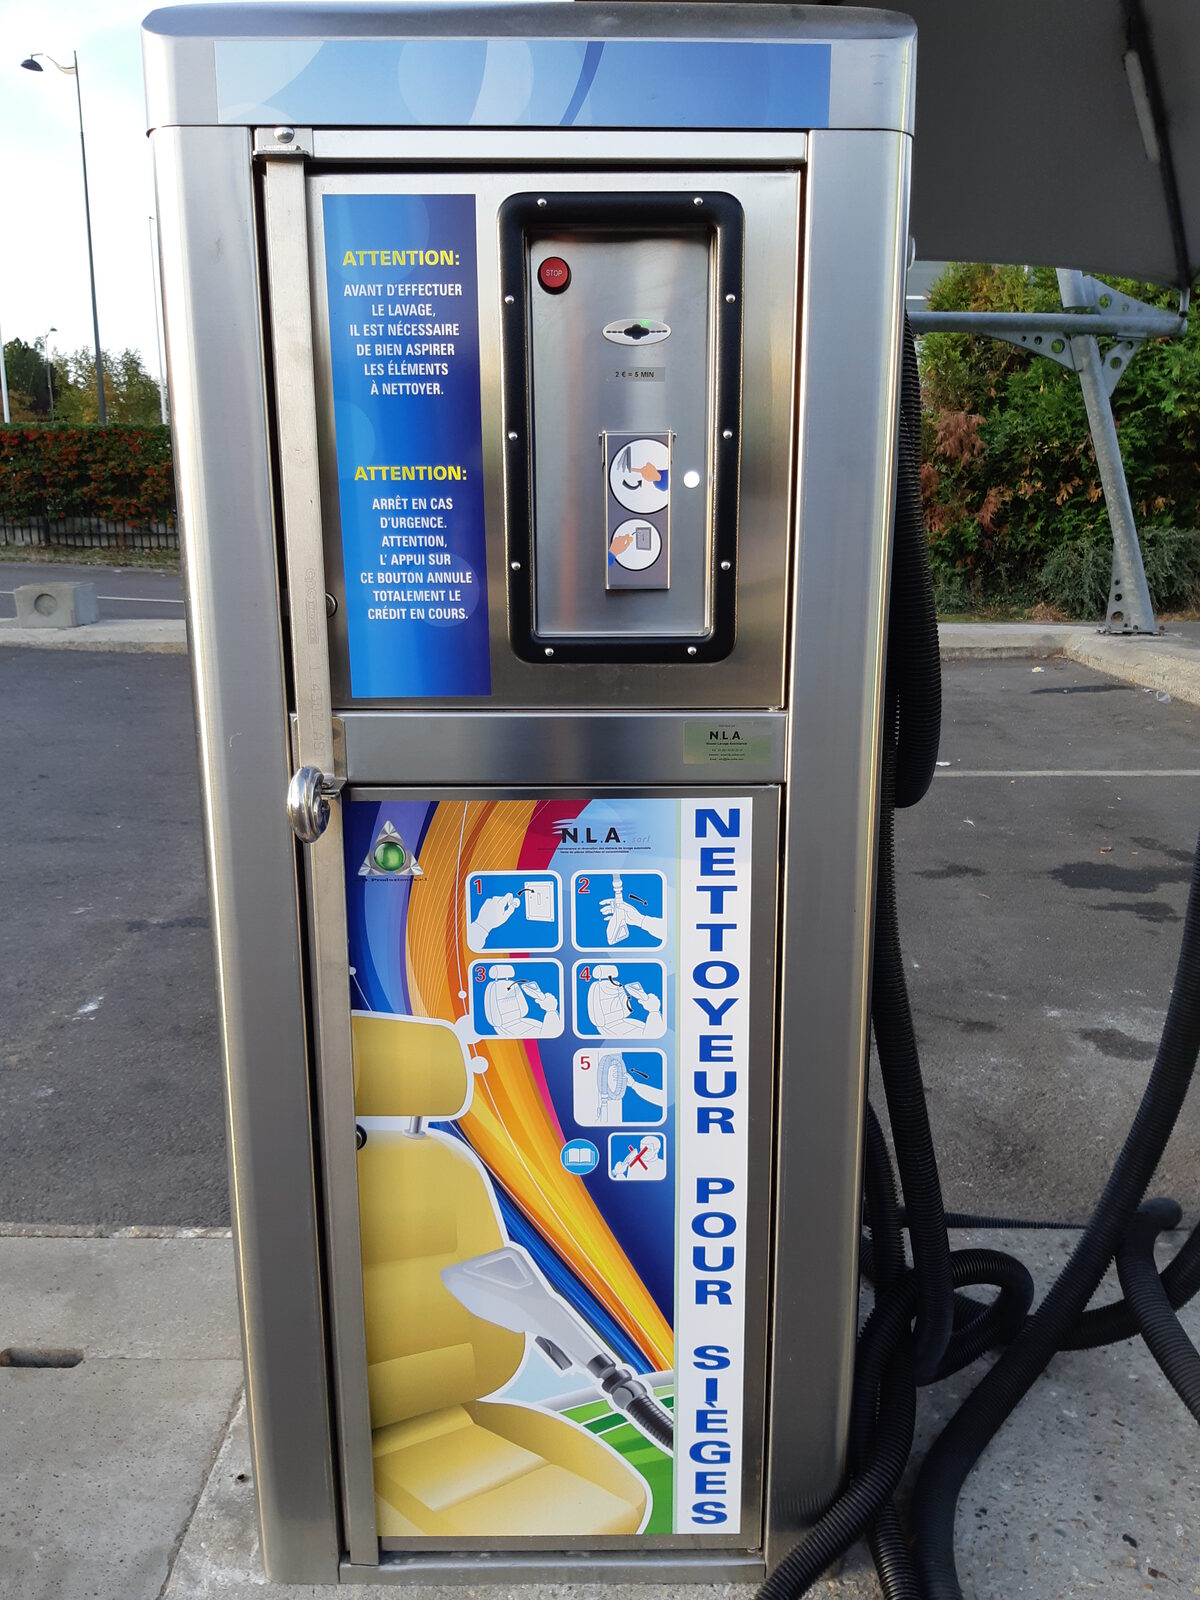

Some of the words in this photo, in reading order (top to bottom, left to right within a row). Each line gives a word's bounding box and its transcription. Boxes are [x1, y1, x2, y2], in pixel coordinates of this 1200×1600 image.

[343, 250, 460, 266] ATTENTION:
[545, 269, 563, 277] STOP
[344, 284, 383, 297] AVANT
[387, 283, 462, 296] D'EFFECTUER
[371, 304, 385, 317] LE
[388, 303, 436, 318] LAVAGE,
[350, 324, 360, 337] IL
[363, 324, 384, 336] EST
[388, 320, 460, 336] NÉCESSAIRE
[356, 344, 372, 357] DE
[375, 344, 402, 356] BIEN
[405, 343, 455, 356] ASPIRER
[364, 363, 384, 376] LES
[388, 360, 449, 376] ÉLÉMENTS
[370, 380, 379, 395] À
[382, 383, 444, 395] NETTOYER.
[354, 466, 467, 481] ATTENTION:
[372, 495, 408, 510] ARRÊT
[412, 498, 427, 510] EN
[430, 498, 453, 510] CAS
[380, 517, 447, 529] D'URGENCE.
[381, 535, 448, 549] ATTENTION,
[391, 554, 425, 565] APPUI
[428, 554, 451, 565] SUR
[360, 572, 374, 584] CE
[377, 572, 424, 584] BOUTON
[427, 572, 473, 583] ANNULE
[373, 590, 446, 602] TOTALEMENT
[449, 590, 461, 602] LE
[368, 605, 407, 620] CRÉDIT
[410, 608, 425, 620] EN
[428, 608, 469, 620] COURS.
[561, 827, 626, 844] N.L.A.
[473, 879, 483, 895] 1
[578, 878, 591, 894] 2
[475, 966, 486, 982] 3
[579, 966, 591, 982] 4
[692, 808, 741, 1134] NETTOYEUR
[580, 1055, 591, 1070] 5
[691, 1177, 737, 1305] POUR
